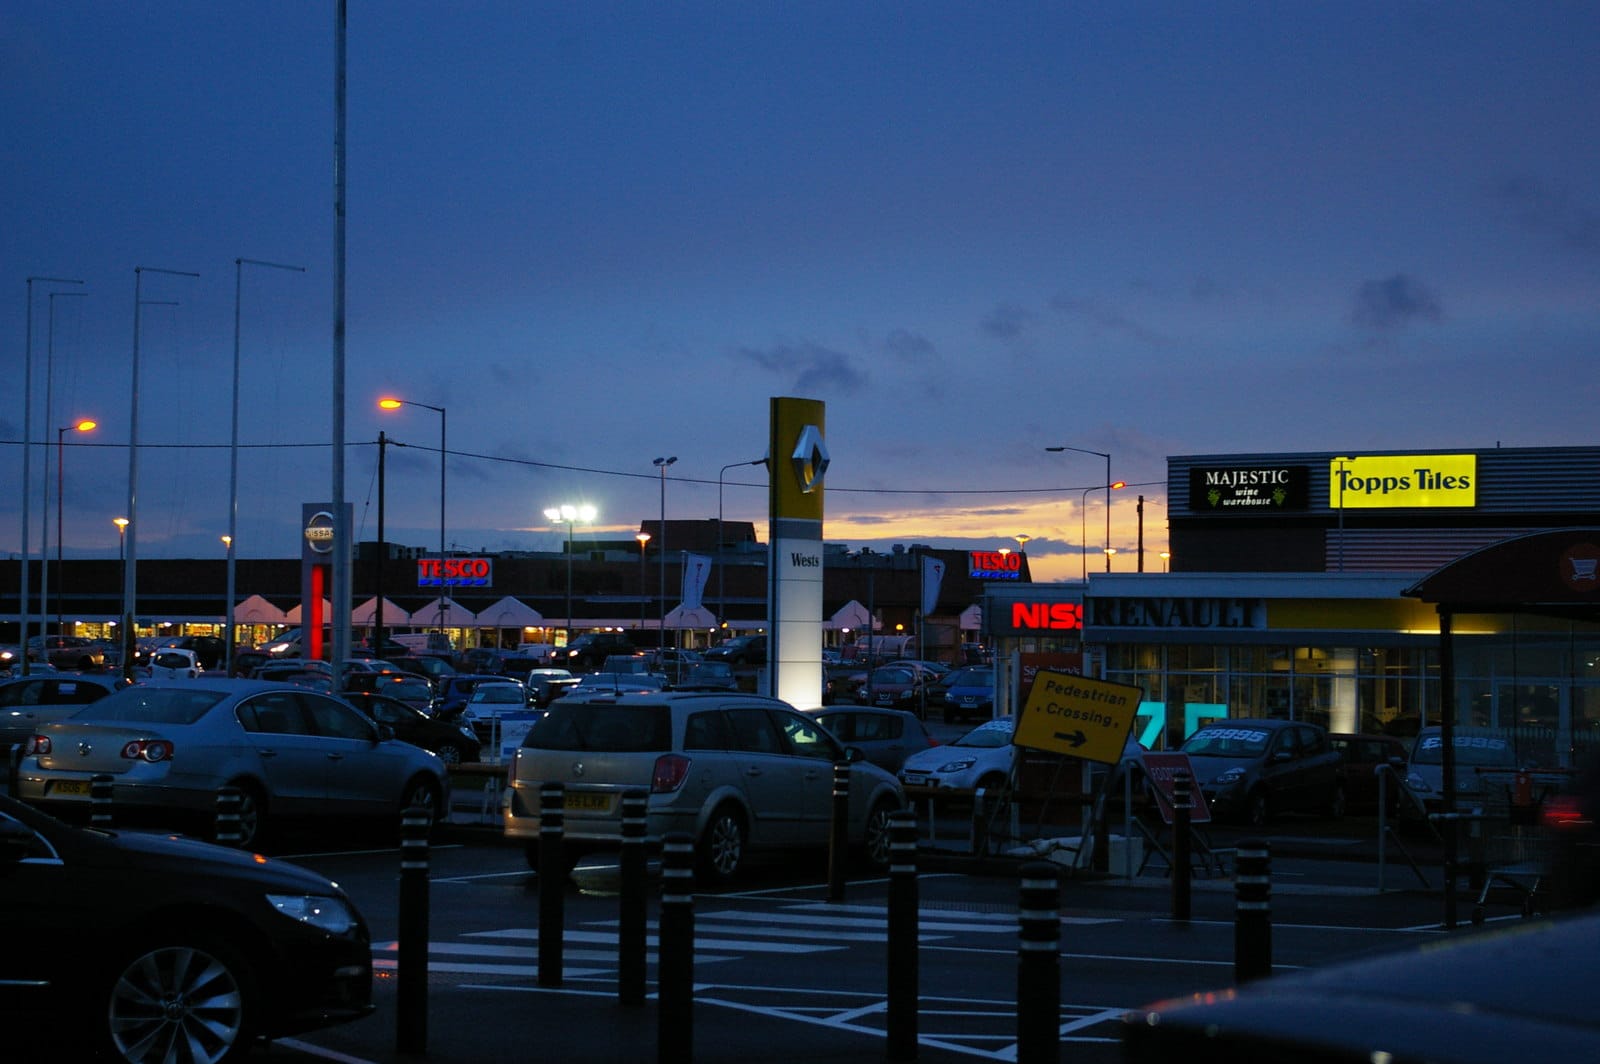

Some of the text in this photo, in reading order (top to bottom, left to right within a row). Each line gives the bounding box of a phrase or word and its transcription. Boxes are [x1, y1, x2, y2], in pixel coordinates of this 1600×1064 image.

[1205, 469, 1289, 488] MAJESTIC
[1335, 469, 1471, 494] Topps Tiles
[1222, 496, 1272, 506] warehouse
[1235, 486, 1259, 497] wine
[416, 559, 490, 578] TESCO
[791, 551, 819, 568] Wests
[1091, 597, 1260, 627] RENAULT
[1045, 680, 1127, 705] Pedestrian
[1047, 702, 1112, 728] Crossing
[1421, 736, 1505, 750] £995
